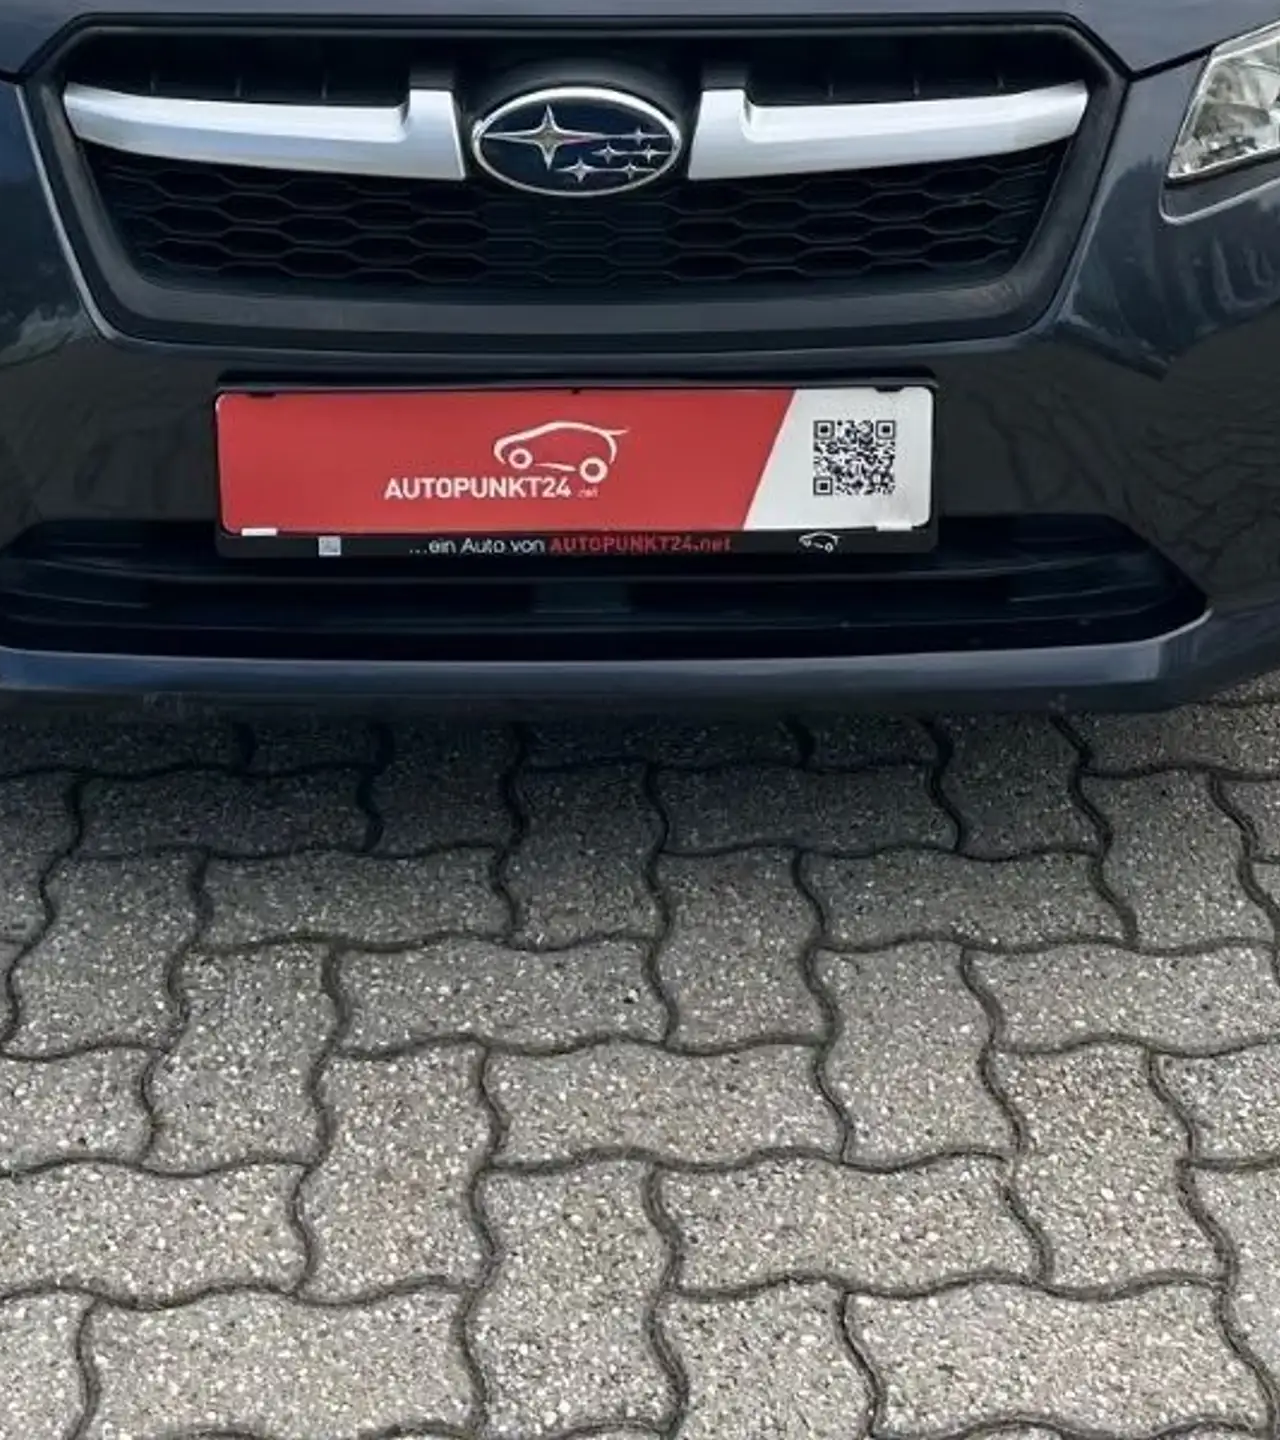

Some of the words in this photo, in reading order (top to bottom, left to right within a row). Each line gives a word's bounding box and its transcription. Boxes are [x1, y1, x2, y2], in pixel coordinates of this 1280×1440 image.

[383, 476, 572, 501] AUTOPUNKT24
[460, 537, 506, 555] Auto
[510, 541, 546, 555] von
[549, 536, 732, 554] AUTOPUNKT24.net
